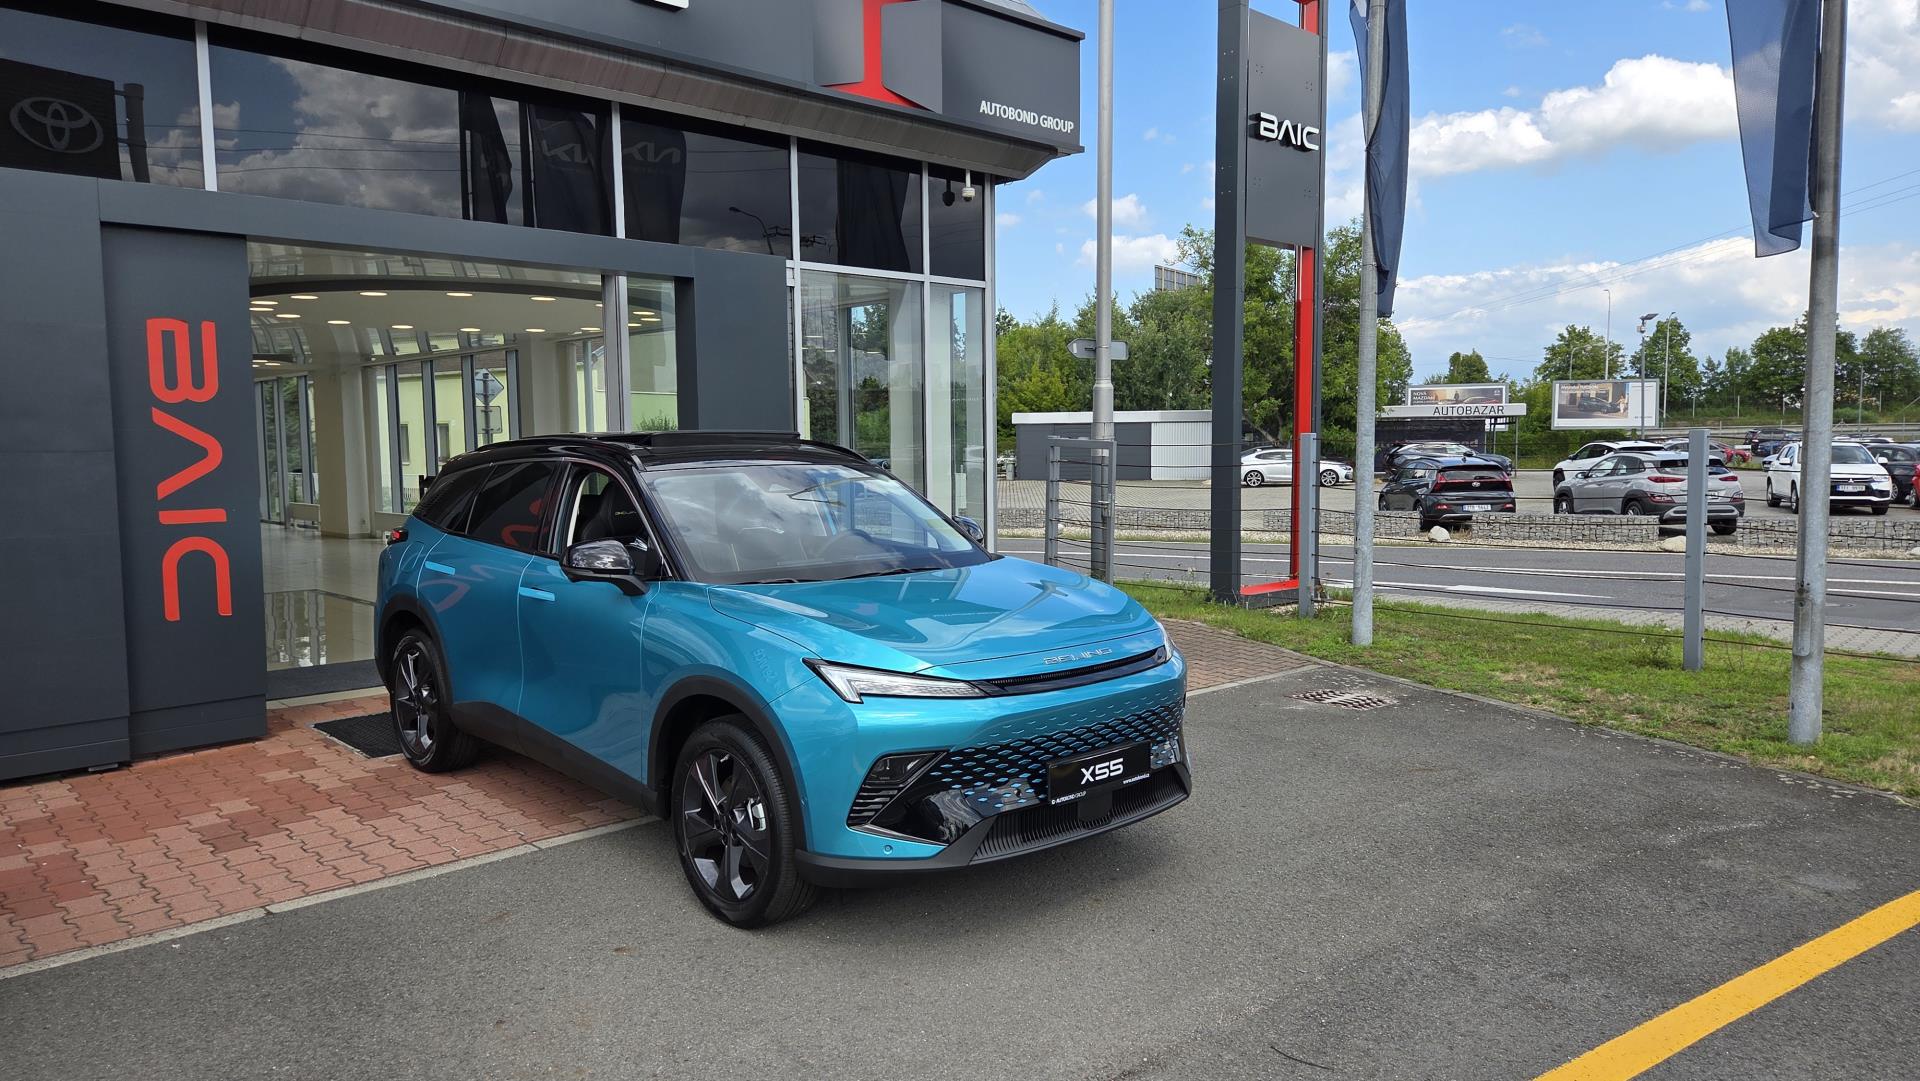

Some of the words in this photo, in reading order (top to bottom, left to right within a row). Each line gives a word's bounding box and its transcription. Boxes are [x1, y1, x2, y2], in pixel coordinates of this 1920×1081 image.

[979, 100, 1038, 125] AUTOBOND
[1039, 115, 1074, 133] GROUP
[1259, 111, 1320, 151] BAIC
[1432, 405, 1505, 416] AUTOBAZAR
[146, 317, 233, 622] BAIC
[1043, 647, 1112, 664] BEIJING
[1080, 757, 1124, 785] X55
